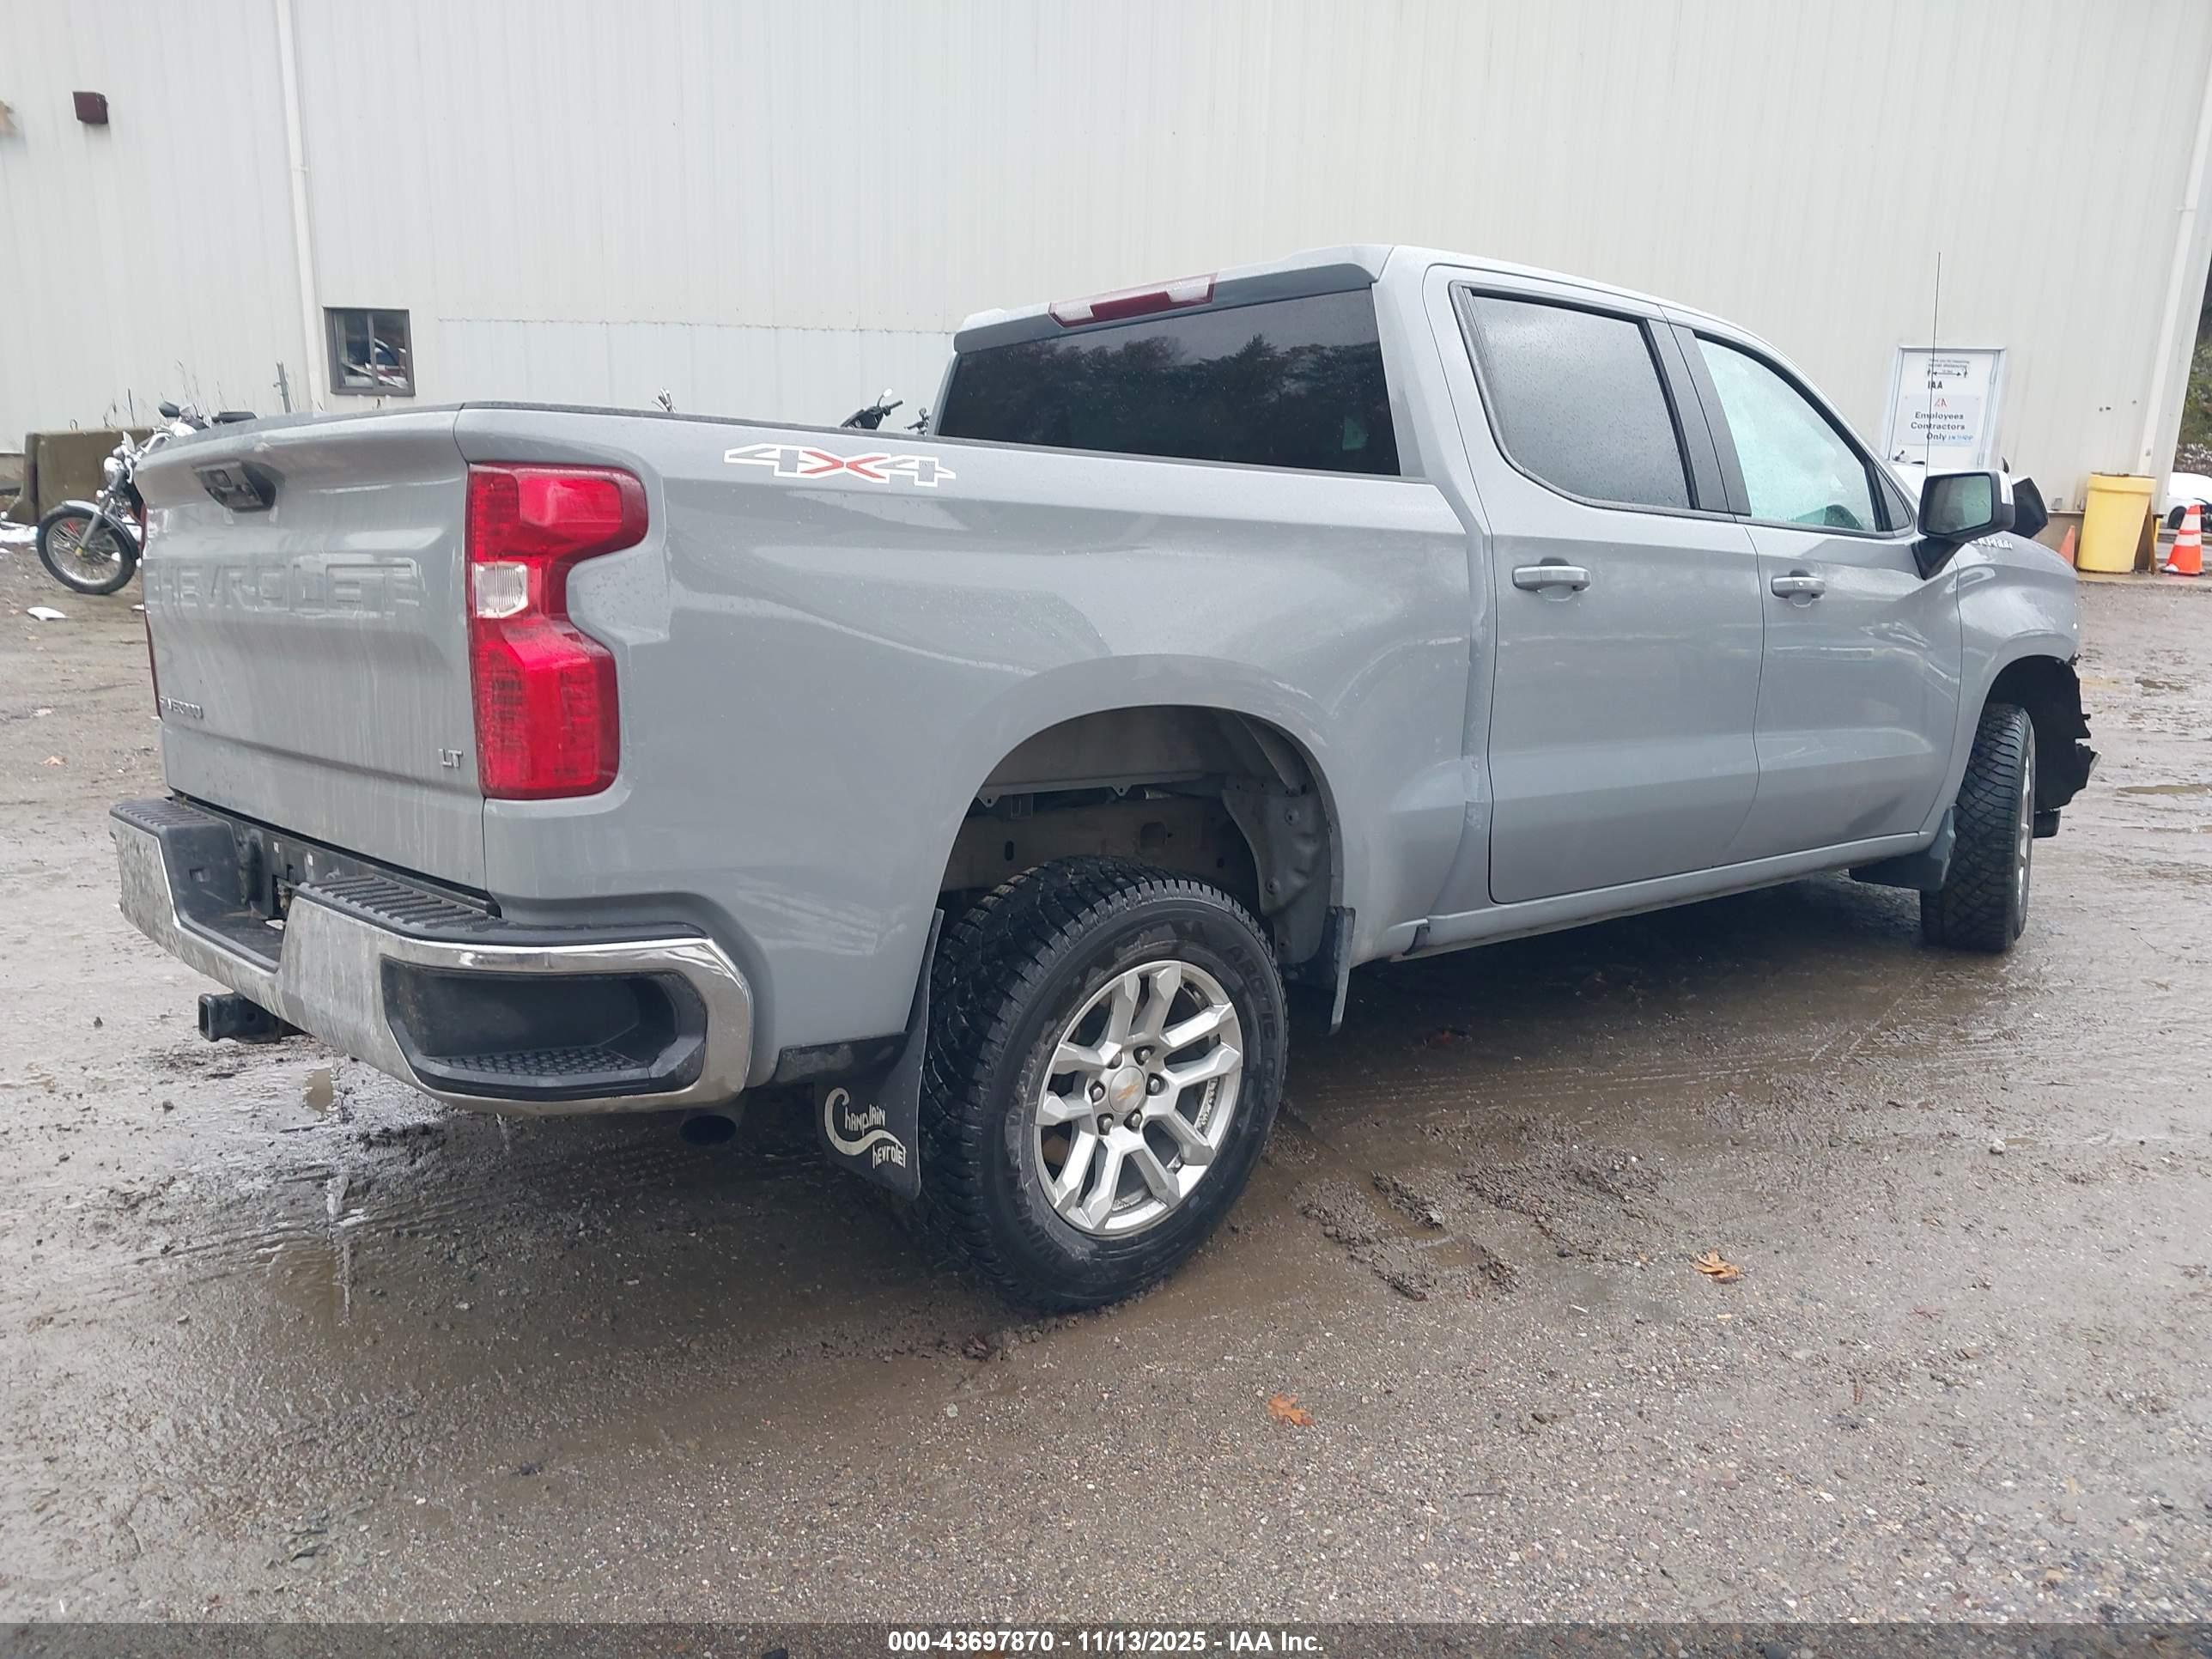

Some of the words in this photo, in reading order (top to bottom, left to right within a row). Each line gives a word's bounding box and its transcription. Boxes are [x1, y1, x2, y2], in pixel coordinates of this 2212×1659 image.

[1927, 380, 1943, 390] IAA
[1915, 411, 1964, 421] Employees
[1911, 422, 1966, 430] Contractors
[1926, 433, 1946, 441] Only
[438, 748, 464, 769] LT
